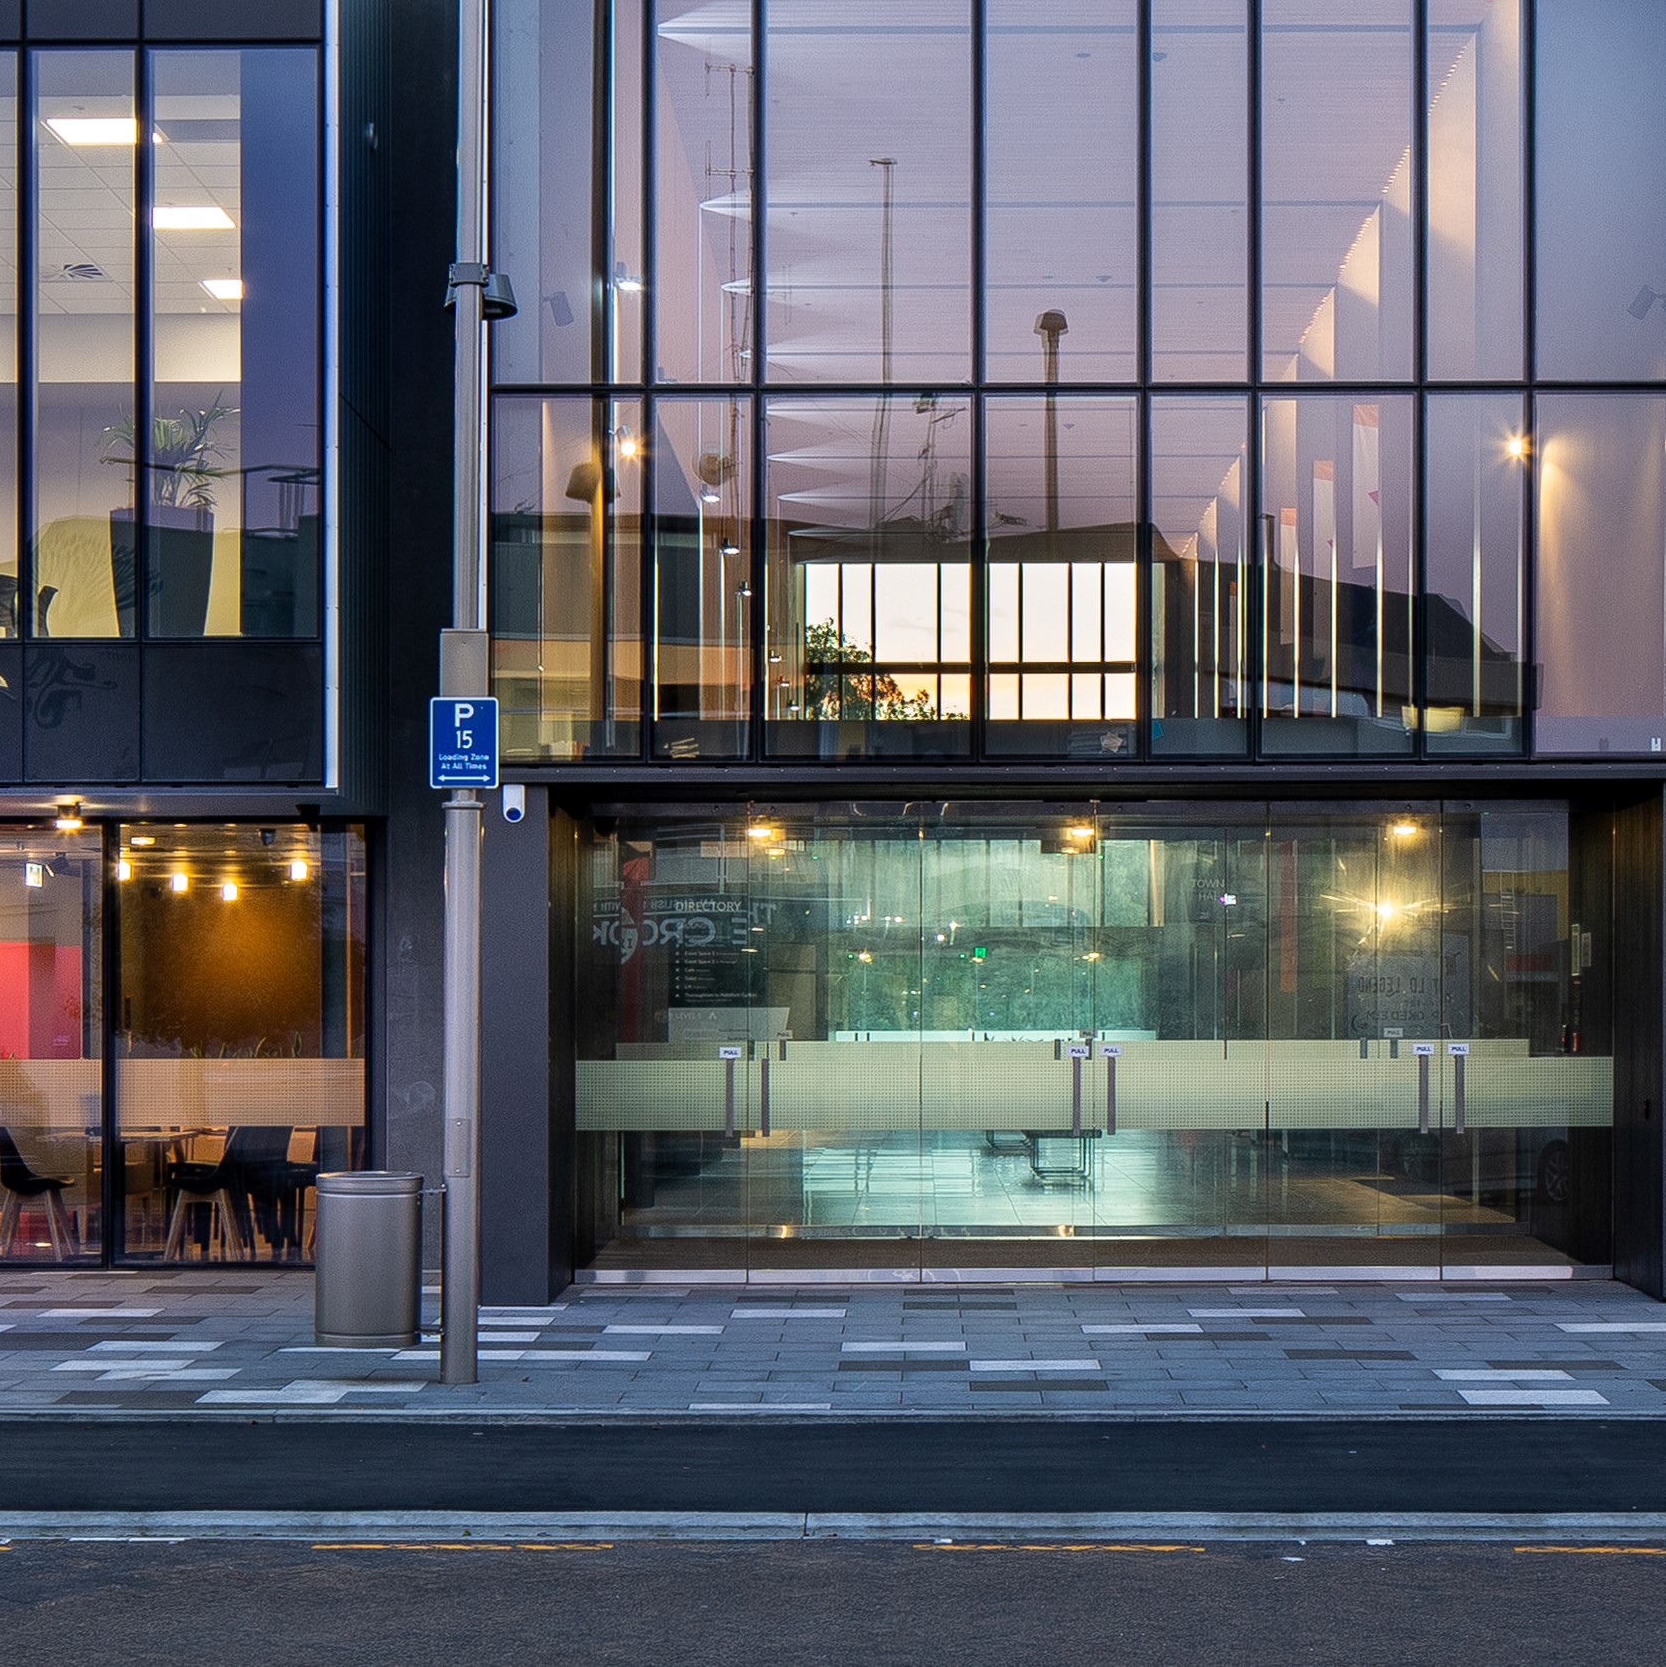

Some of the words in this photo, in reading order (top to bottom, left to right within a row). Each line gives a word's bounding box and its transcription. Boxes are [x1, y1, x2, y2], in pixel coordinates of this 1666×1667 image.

[455, 703, 474, 727] P
[456, 730, 474, 749] 15
[438, 753, 469, 762] Loading
[470, 752, 490, 761] Zone
[441, 762, 451, 770] At
[452, 762, 463, 770] All
[464, 762, 488, 770] Times
[1190, 878, 1225, 888] TOWN
[675, 900, 742, 912] DIRECTORY
